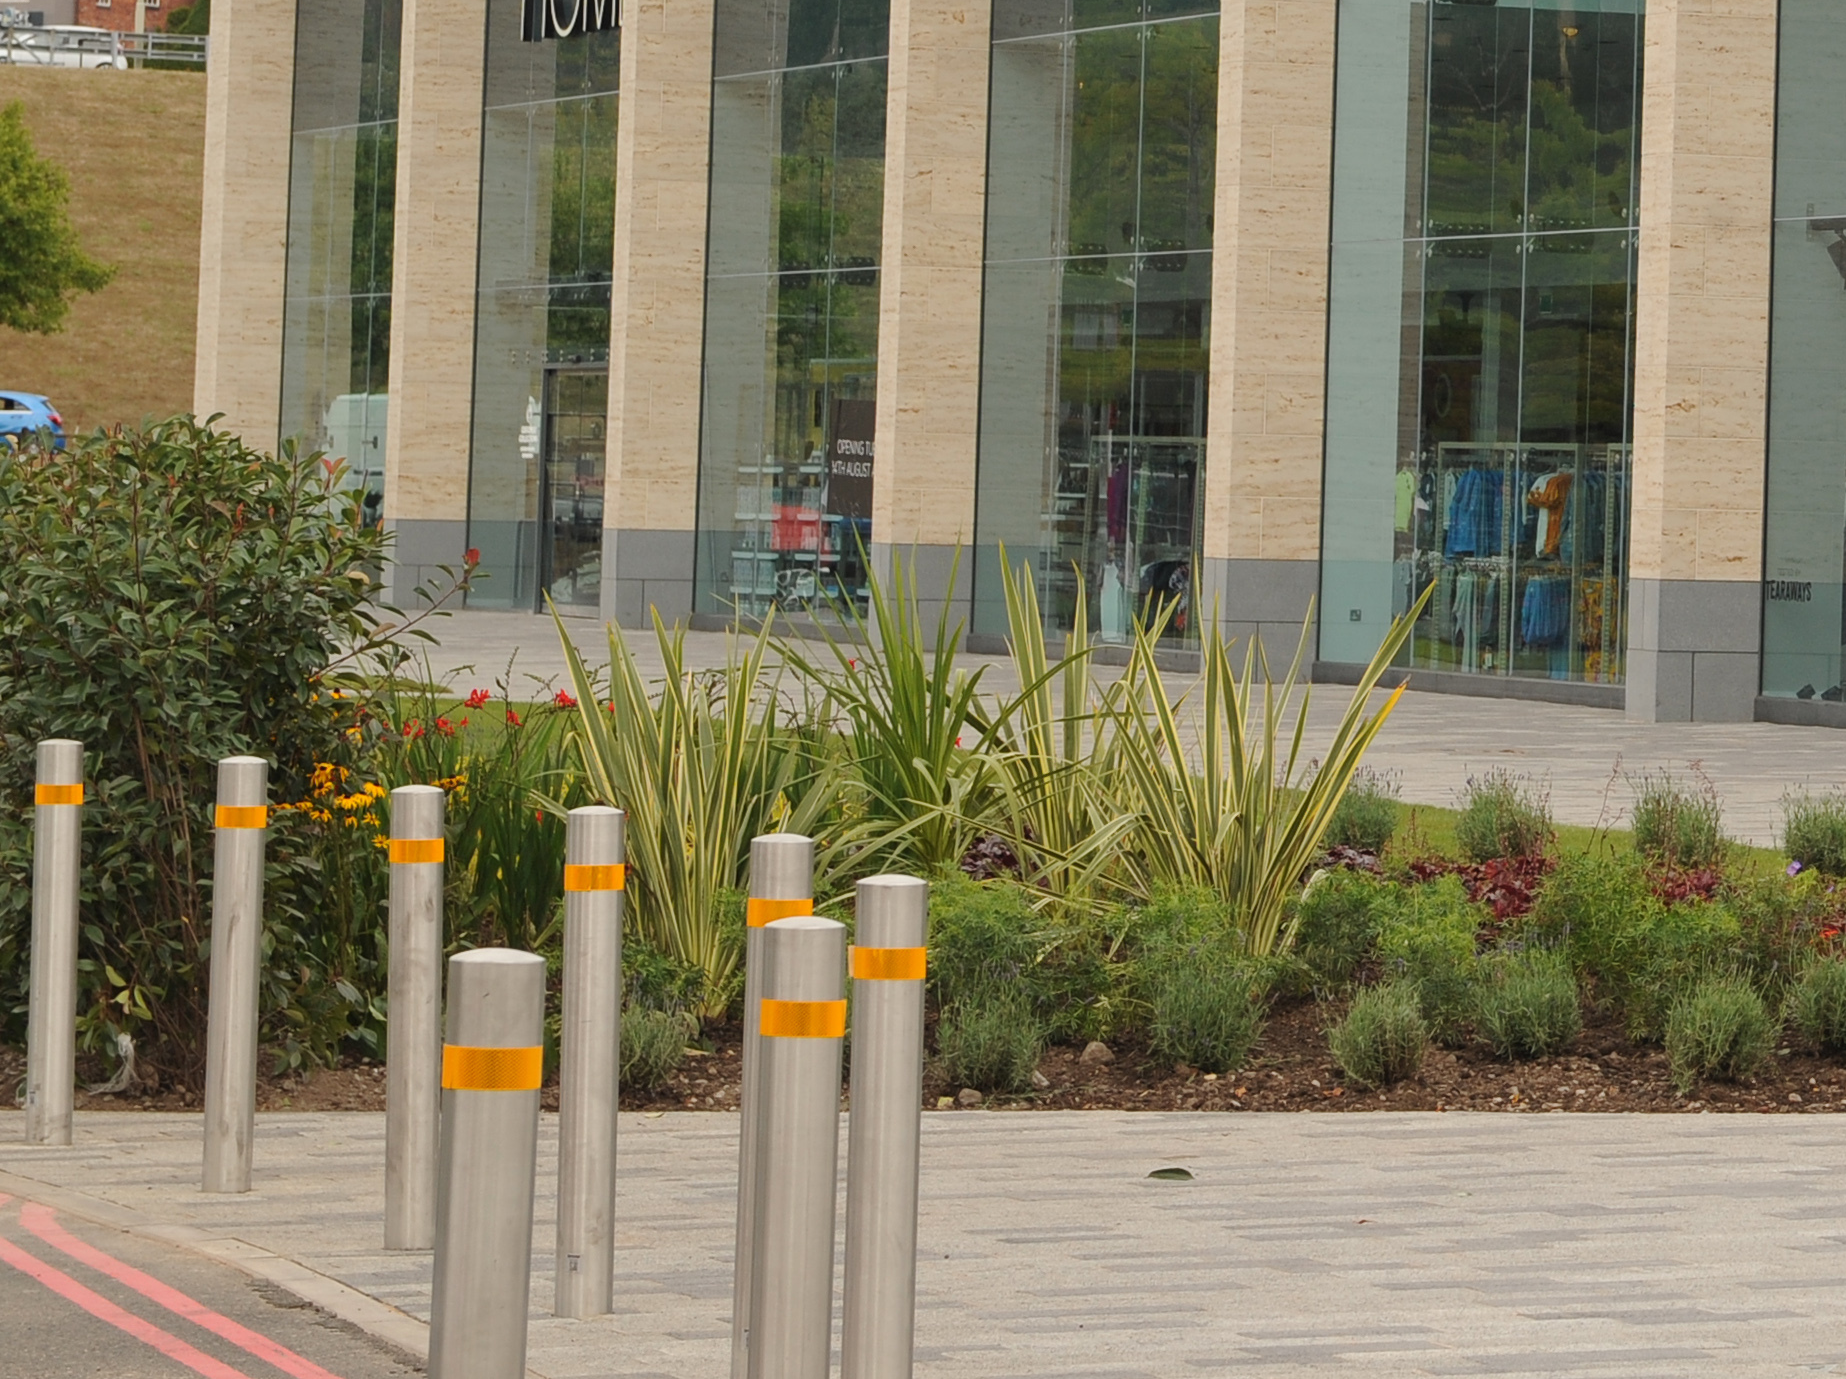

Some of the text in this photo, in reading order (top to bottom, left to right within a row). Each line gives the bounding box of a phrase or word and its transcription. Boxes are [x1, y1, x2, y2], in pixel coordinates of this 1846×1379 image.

[837, 439, 864, 456] OPENING
[846, 462, 871, 478] AUGUST
[1766, 580, 1812, 602] TEARAWAYS
